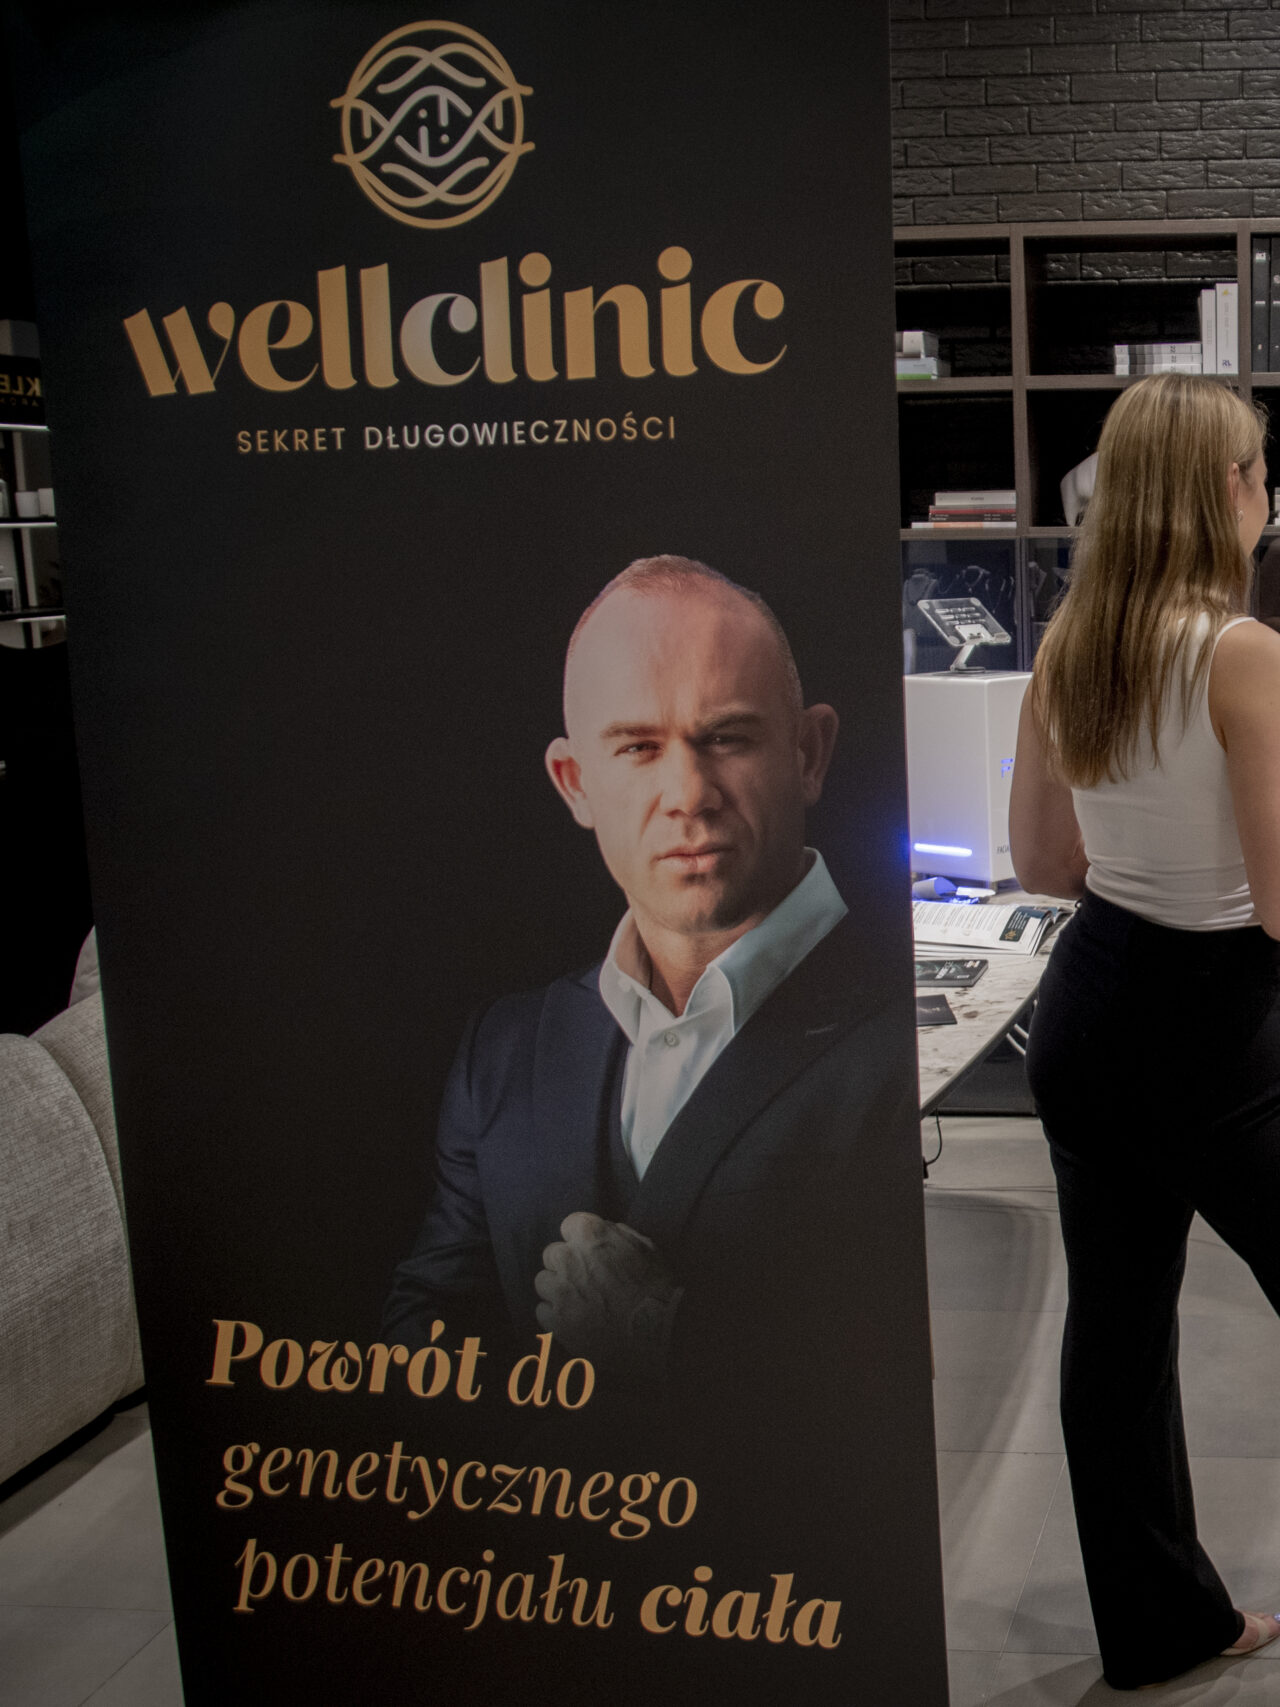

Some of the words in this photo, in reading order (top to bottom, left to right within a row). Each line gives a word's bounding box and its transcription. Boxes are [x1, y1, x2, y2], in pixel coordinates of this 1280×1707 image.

[123, 246, 787, 397] wellclinic
[237, 427, 346, 454] SEKRET
[363, 412, 677, 452] DŁUGOWIECZNOŚCI
[205, 1318, 485, 1403] Powrót
[507, 1333, 596, 1411] do
[216, 1439, 699, 1541] genetycznego
[233, 1538, 614, 1632] potencjału
[639, 1565, 842, 1650] ciała
